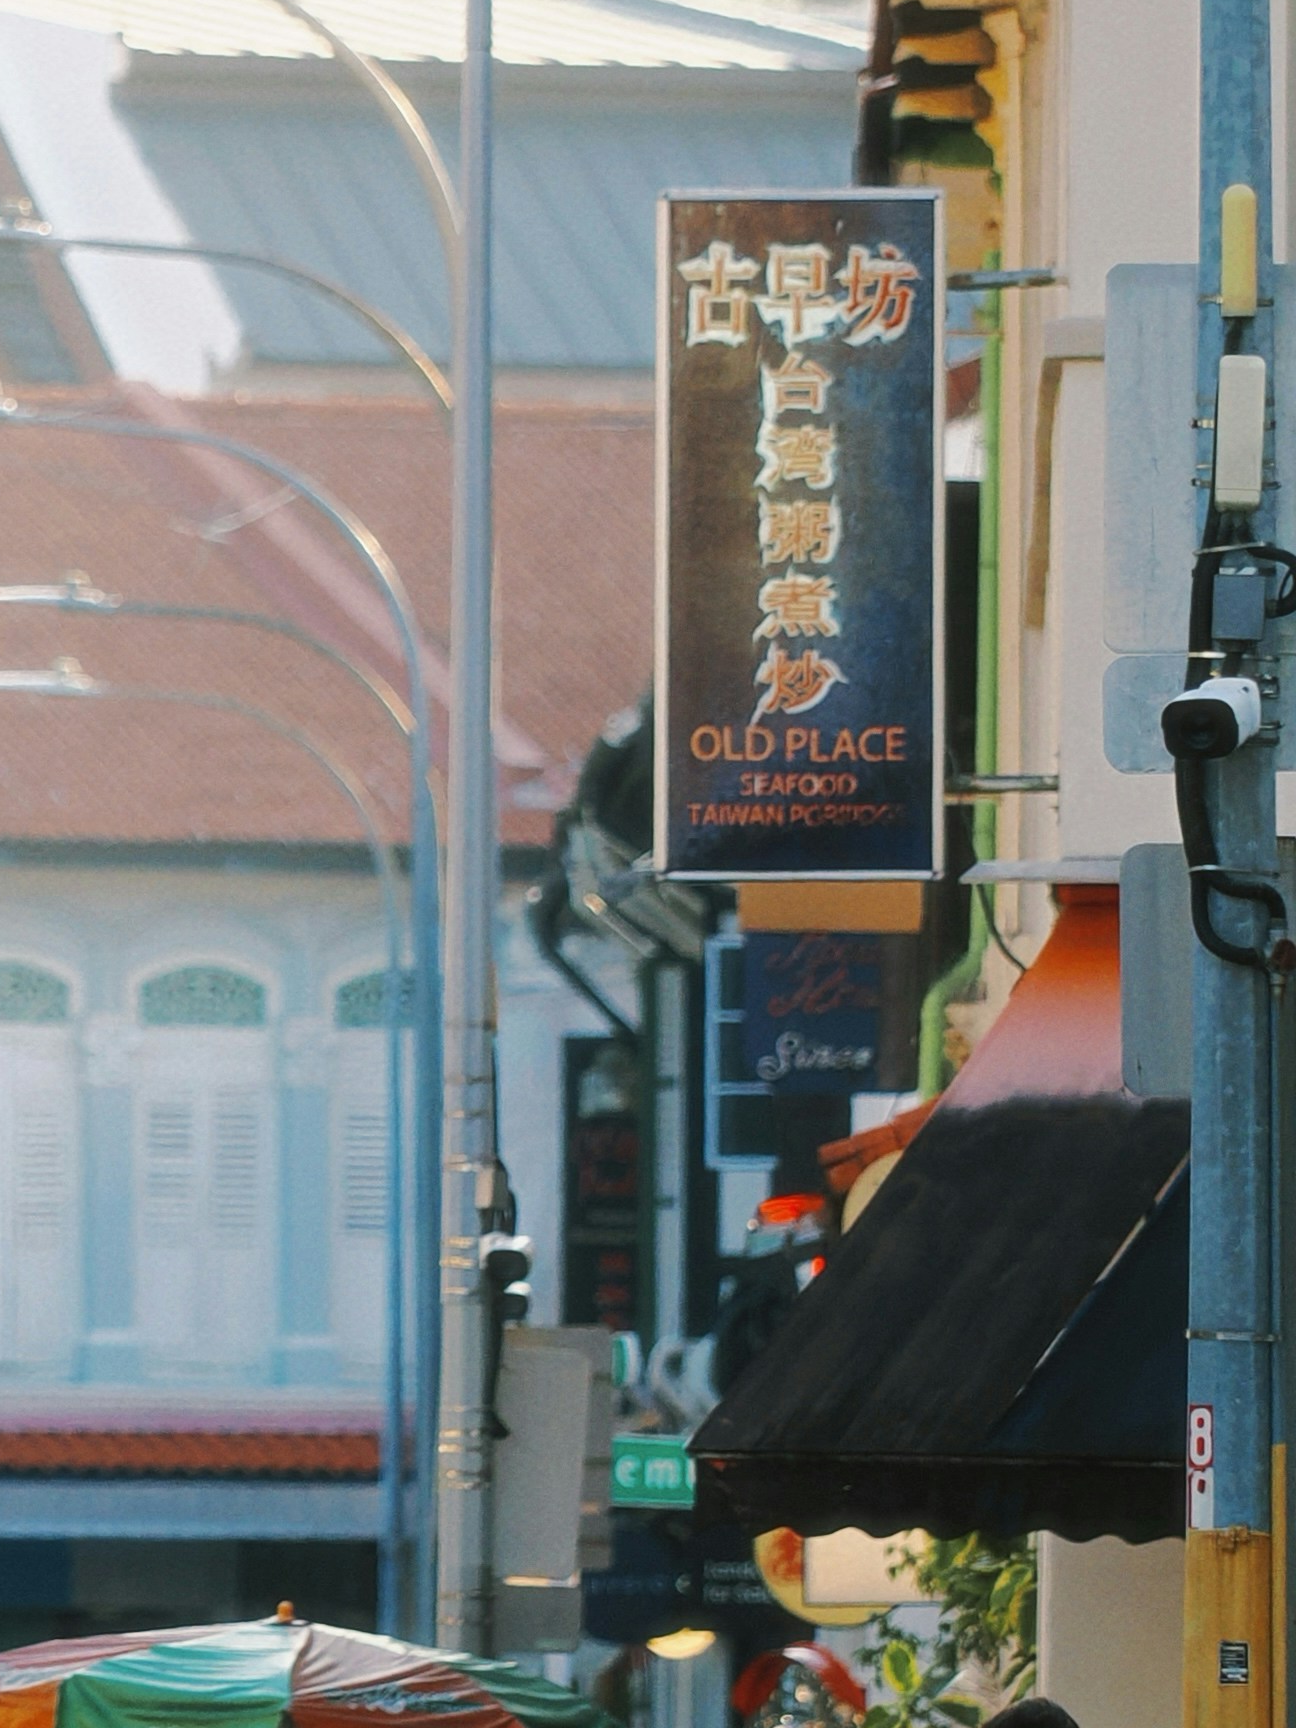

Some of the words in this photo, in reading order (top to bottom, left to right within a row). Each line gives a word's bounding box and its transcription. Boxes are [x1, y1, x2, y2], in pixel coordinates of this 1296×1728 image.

[677, 241, 919, 348] 古早坊
[755, 350, 845, 716] 台湾粥煮炒
[689, 724, 777, 762] OLD
[784, 725, 907, 763] PLACE
[739, 771, 858, 797] SEAFOOD
[687, 802, 785, 826] TAIWAN
